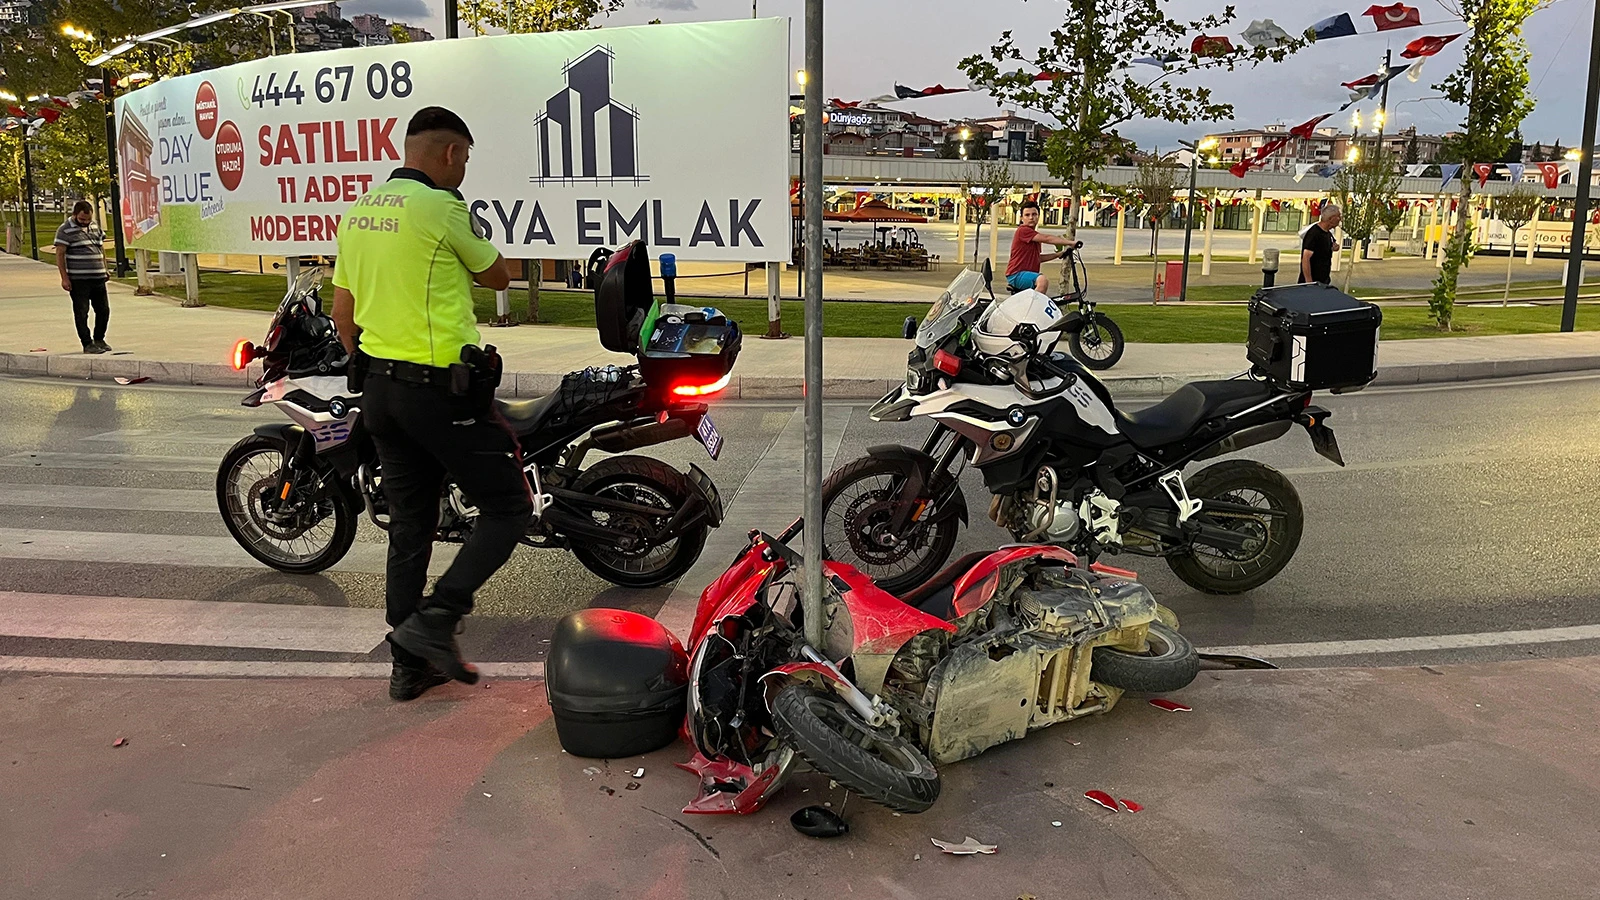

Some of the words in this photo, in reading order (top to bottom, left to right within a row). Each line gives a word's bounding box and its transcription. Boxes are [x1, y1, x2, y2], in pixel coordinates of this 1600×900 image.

[251, 70, 305, 108] 444
[315, 65, 354, 103] 67
[366, 60, 413, 100] 08
[830, 112, 873, 125] Dünyagöz
[160, 133, 193, 165] DAY
[216, 142, 242, 154] OTURUMA
[258, 117, 401, 167] SATILIK
[221, 156, 241, 171] HAZIR!
[162, 172, 213, 203] BLUE
[277, 177, 297, 203] 11
[304, 174, 373, 203] ADET
[250, 214, 341, 242] MODERN
[470, 199, 556, 245] SYA
[576, 199, 764, 248] EMLAK
[1522, 233, 1557, 243] cffee
